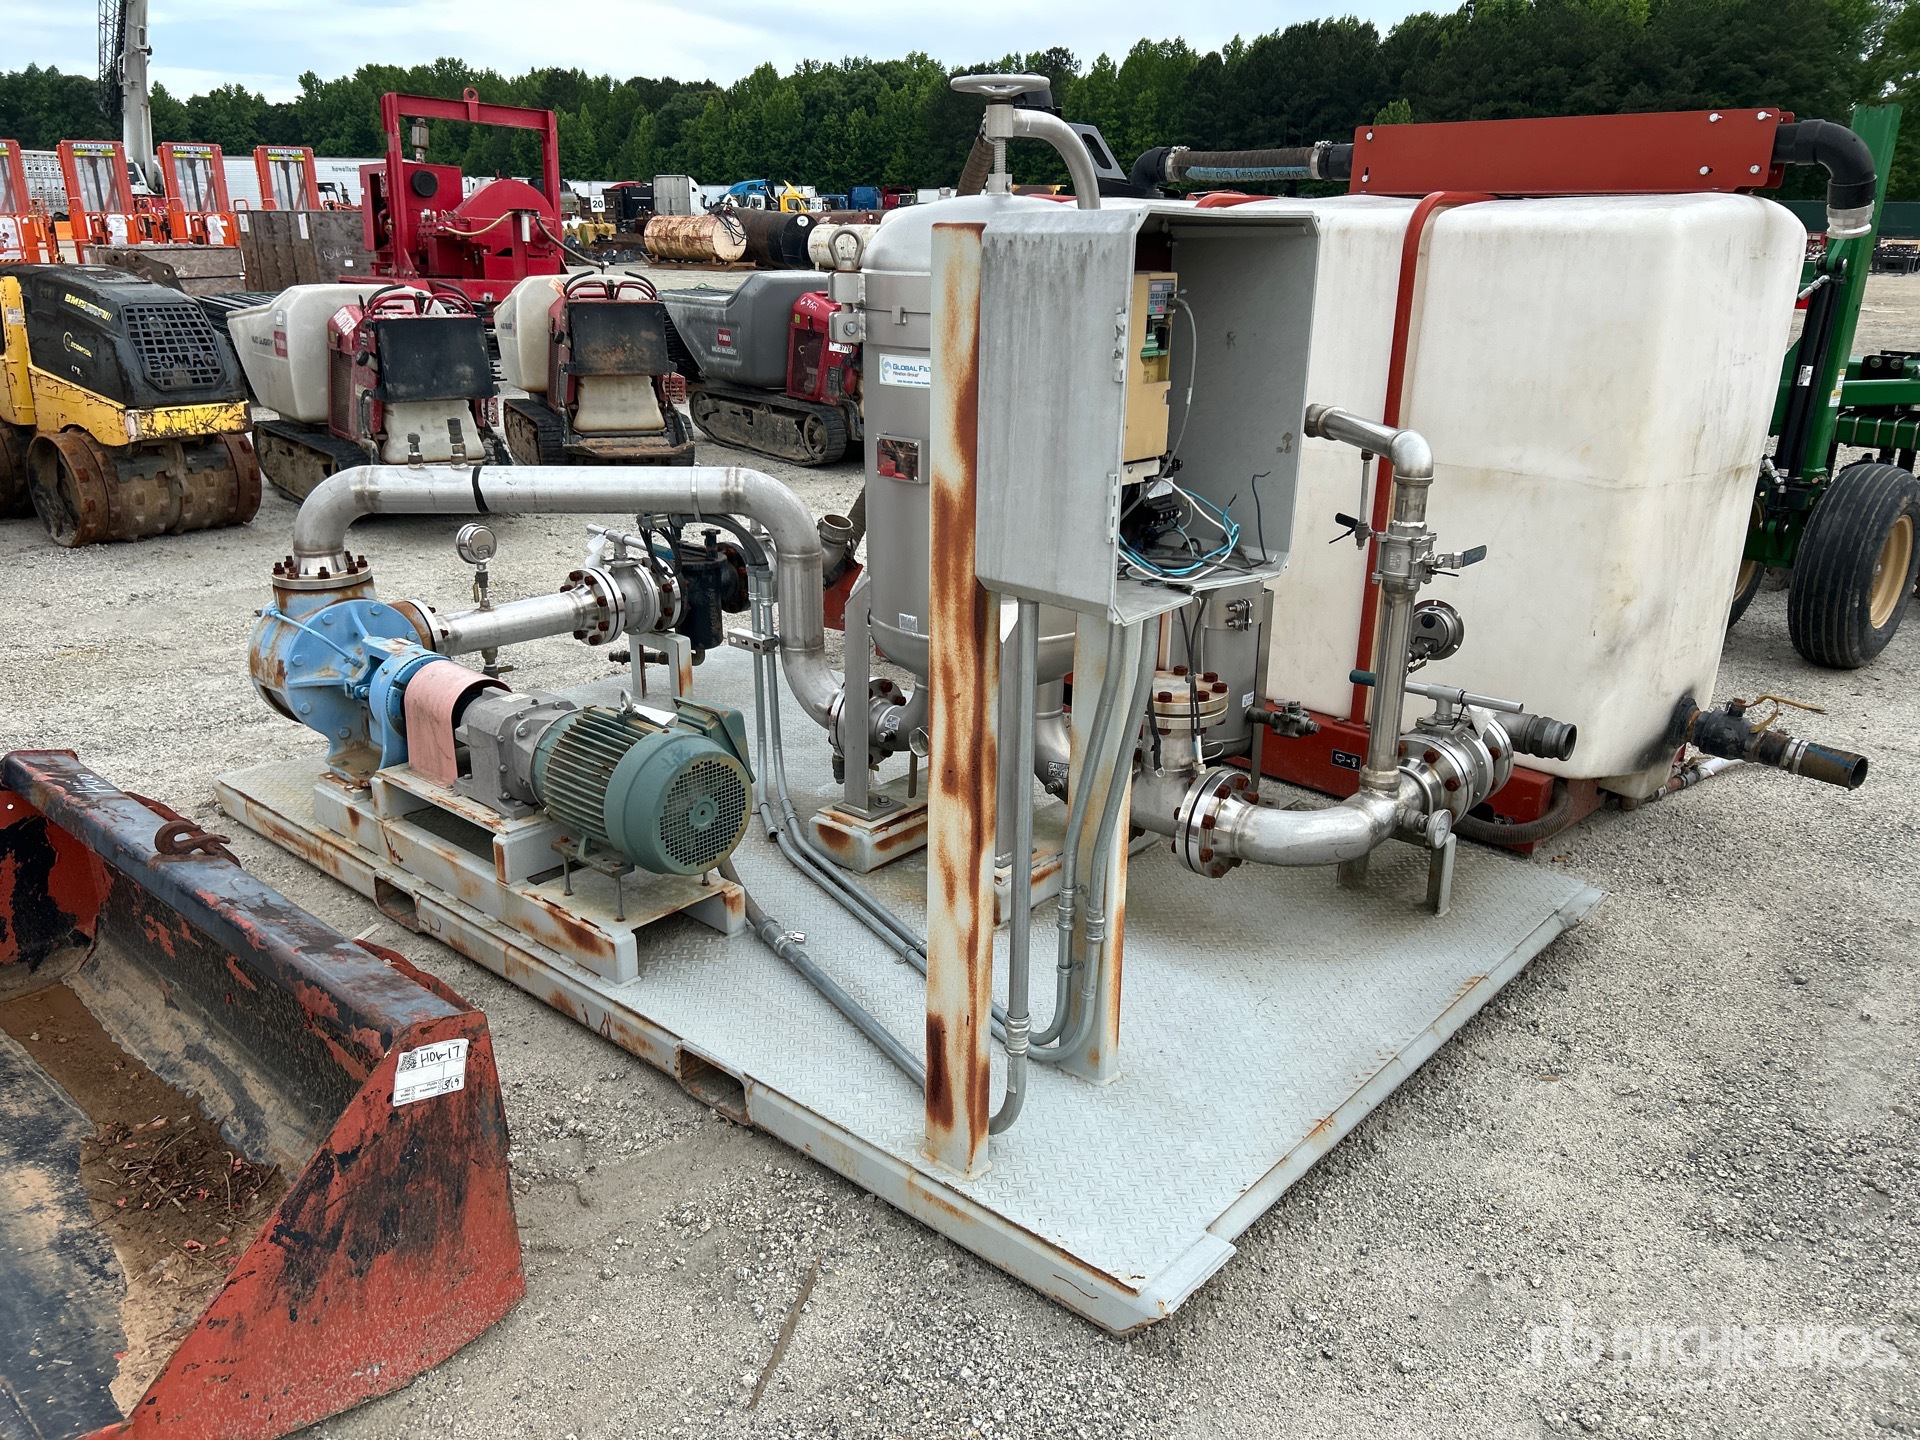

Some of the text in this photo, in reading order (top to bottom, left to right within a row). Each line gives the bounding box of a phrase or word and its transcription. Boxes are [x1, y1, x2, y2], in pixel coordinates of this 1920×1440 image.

[592, 199, 604, 209] 20
[718, 333, 731, 342] TORO
[147, 352, 217, 370] BOMAG
[892, 363, 918, 372] GLOBAL
